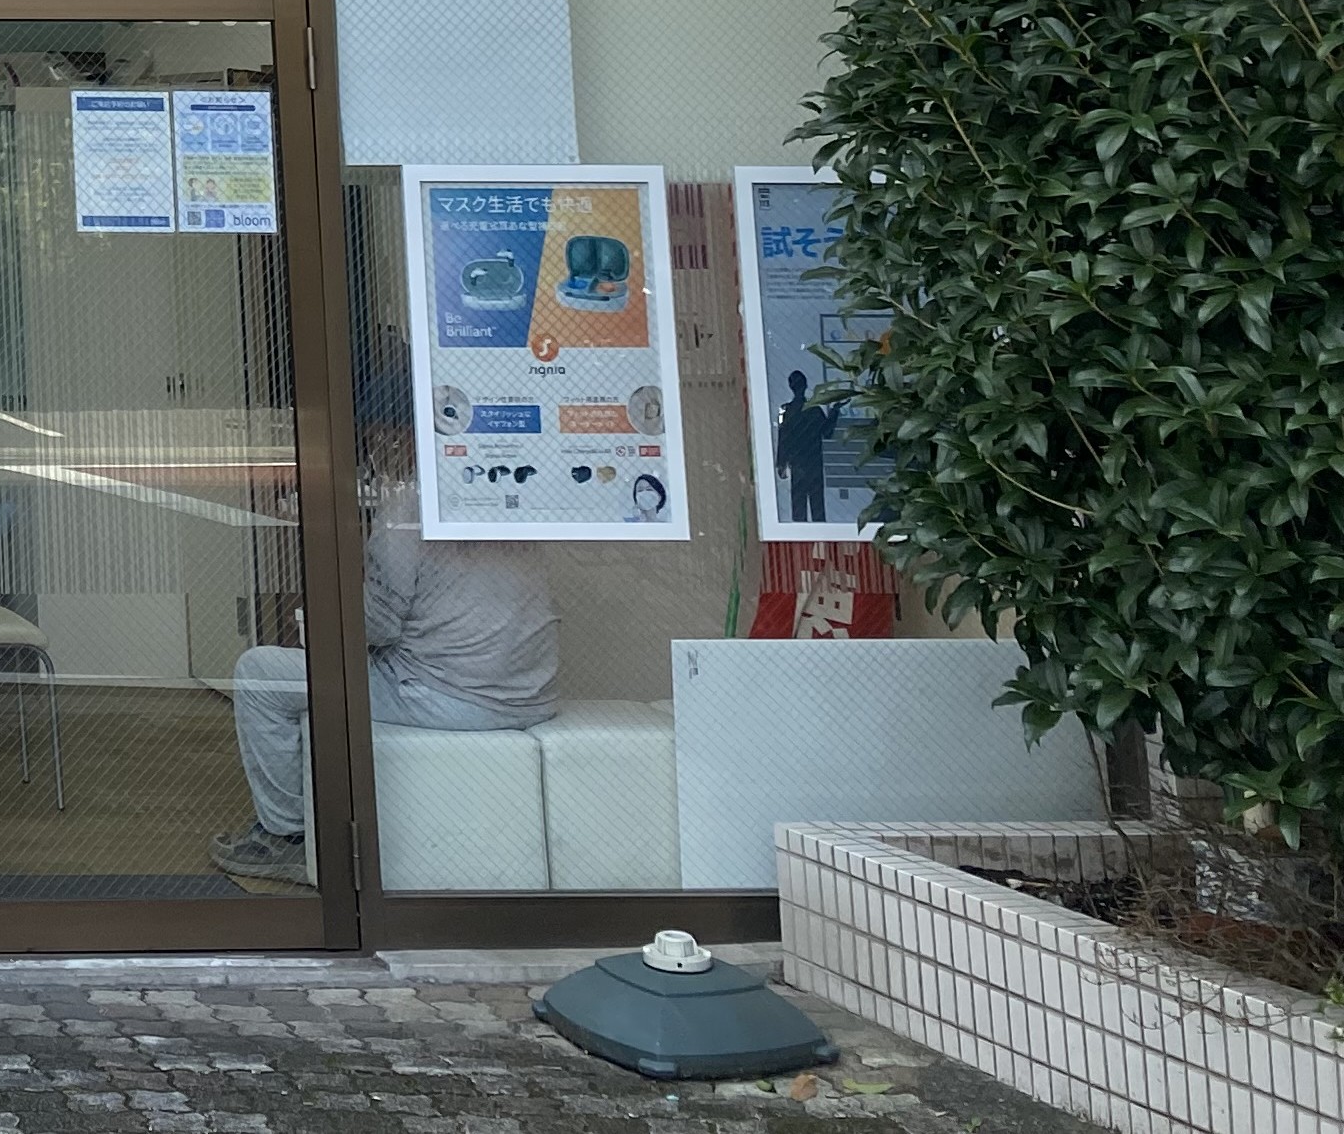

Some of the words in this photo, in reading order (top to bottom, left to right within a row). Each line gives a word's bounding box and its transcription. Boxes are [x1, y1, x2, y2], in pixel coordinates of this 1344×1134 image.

[437, 195, 593, 213] マスク生活でも快適
[233, 214, 271, 227] bloom
[445, 312, 462, 324] Be
[528, 366, 566, 378] signia
